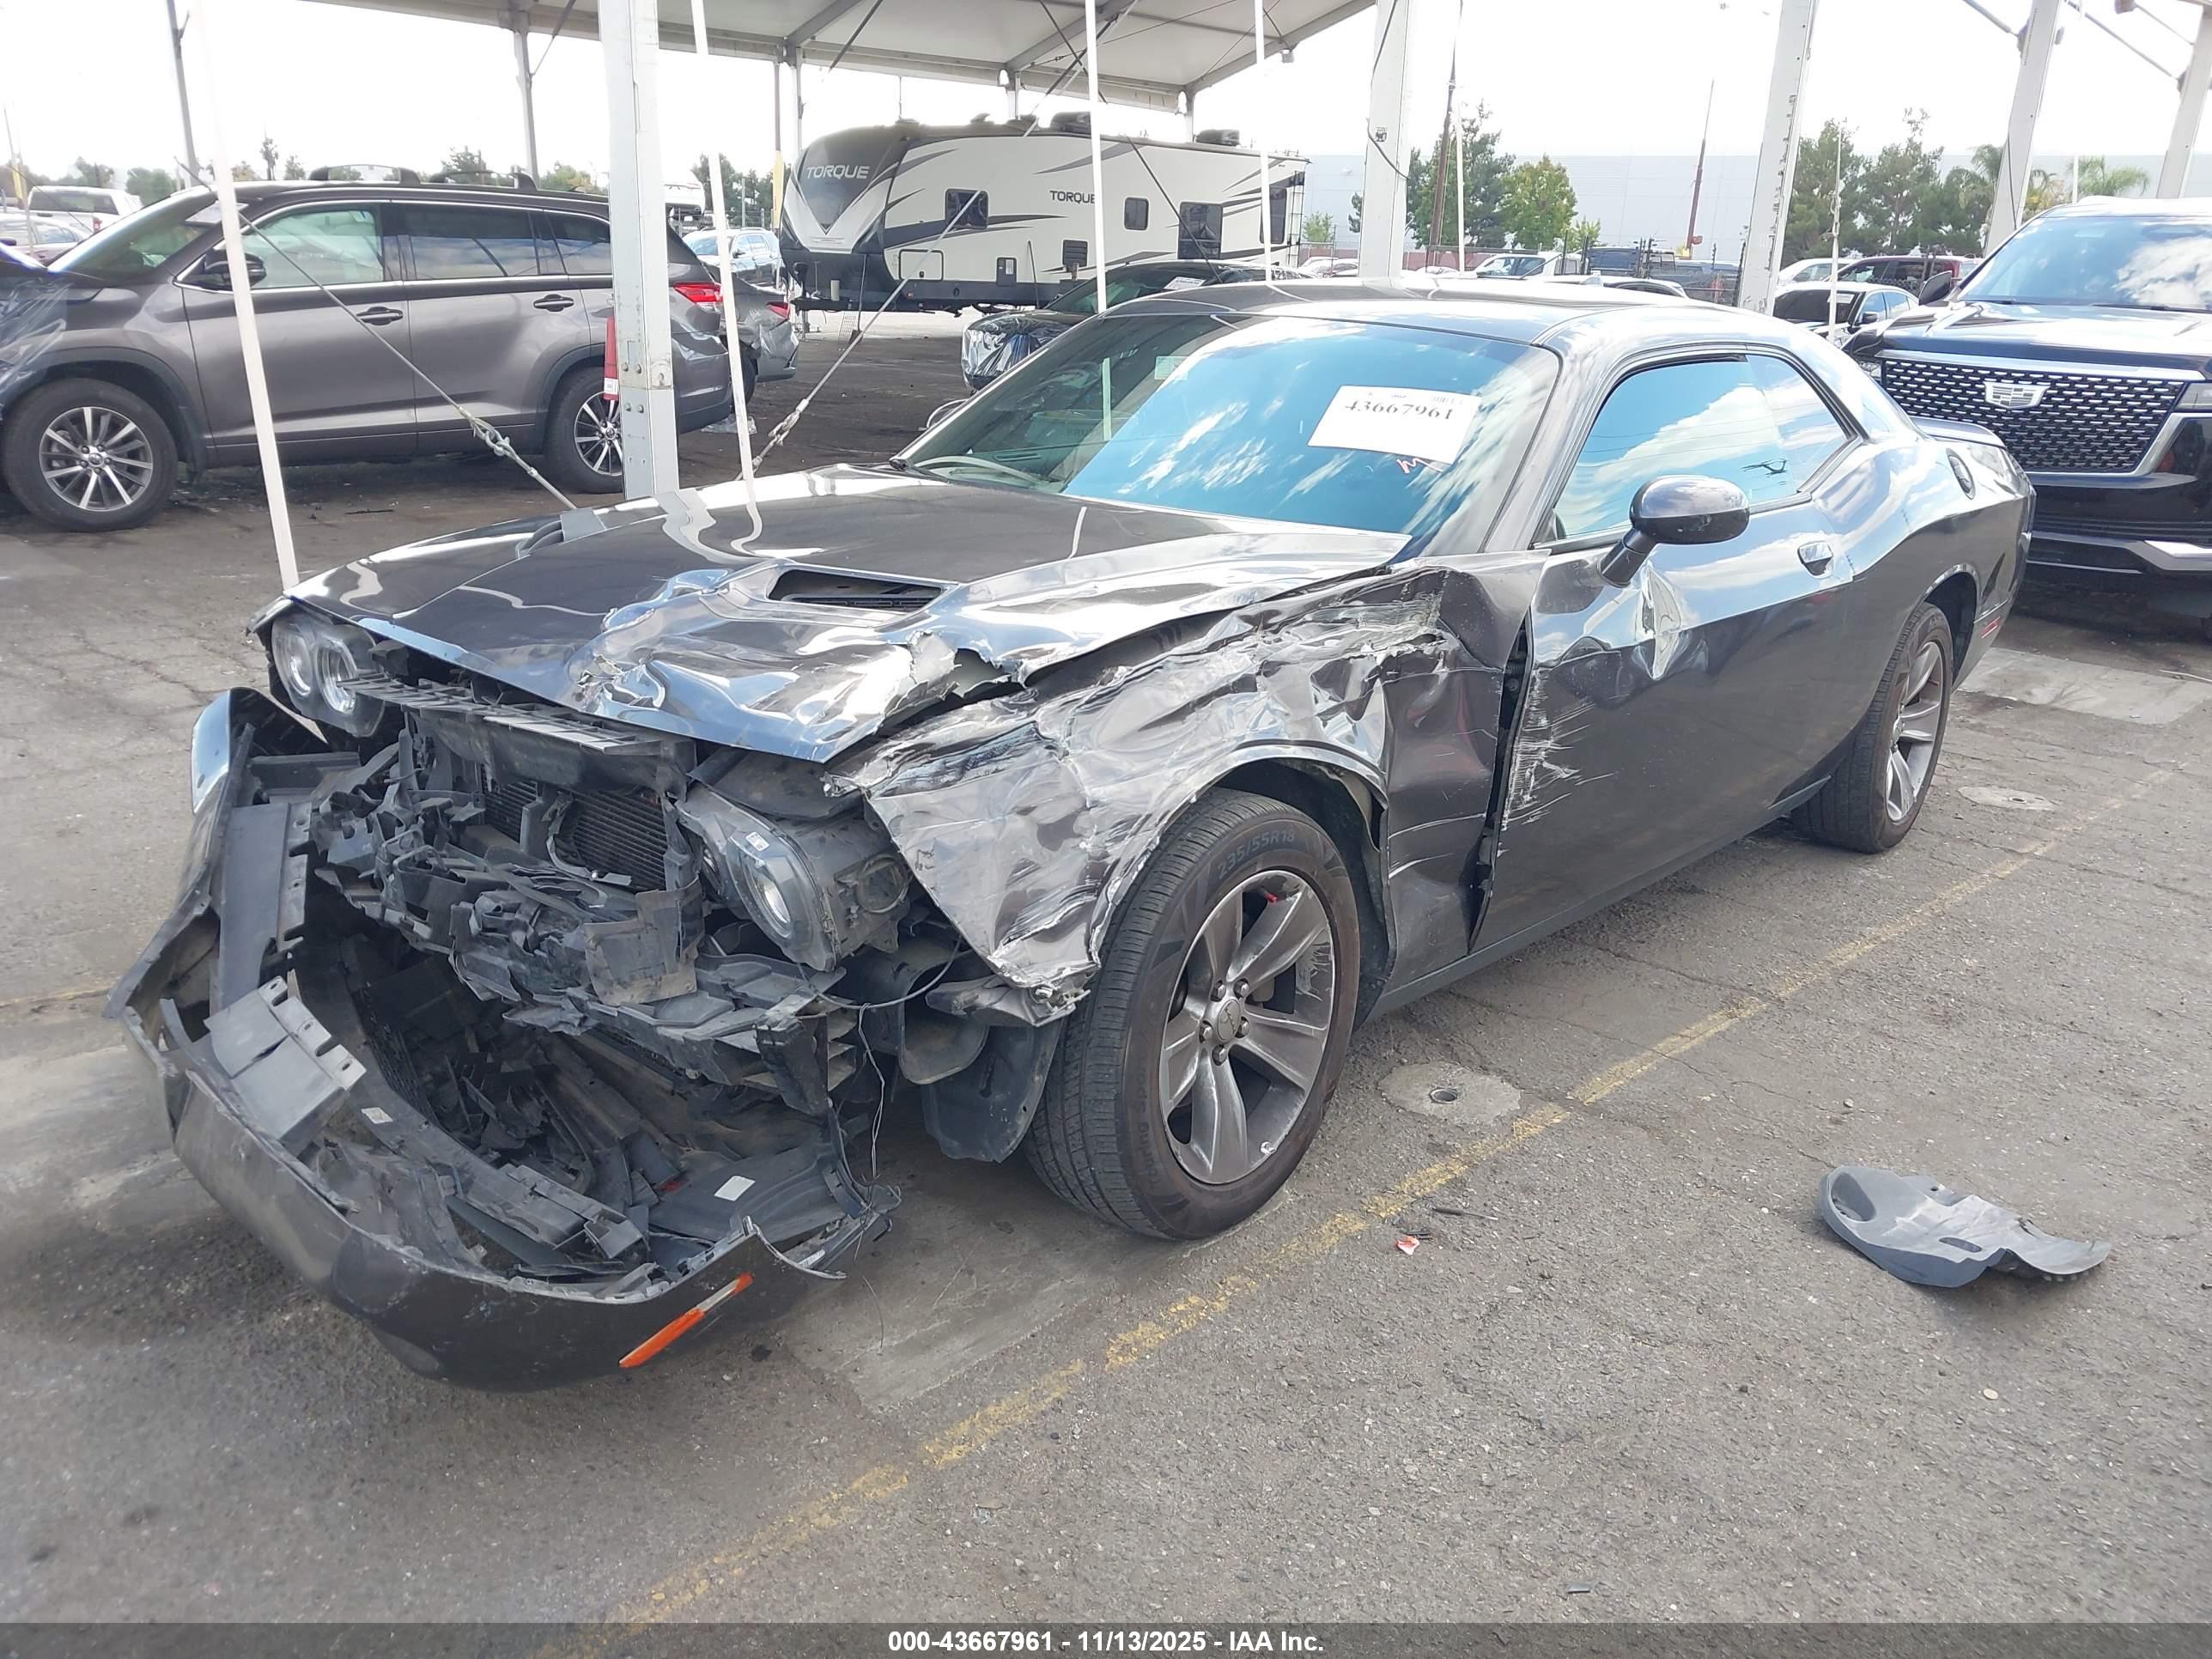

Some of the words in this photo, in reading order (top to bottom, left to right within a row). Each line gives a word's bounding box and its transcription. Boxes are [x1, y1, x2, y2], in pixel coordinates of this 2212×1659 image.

[806, 164, 870, 179] TORQUE
[1049, 190, 1096, 204] TORQUE
[1344, 399, 1455, 420] 43667961
[1217, 829, 1296, 880] 235/55R18
